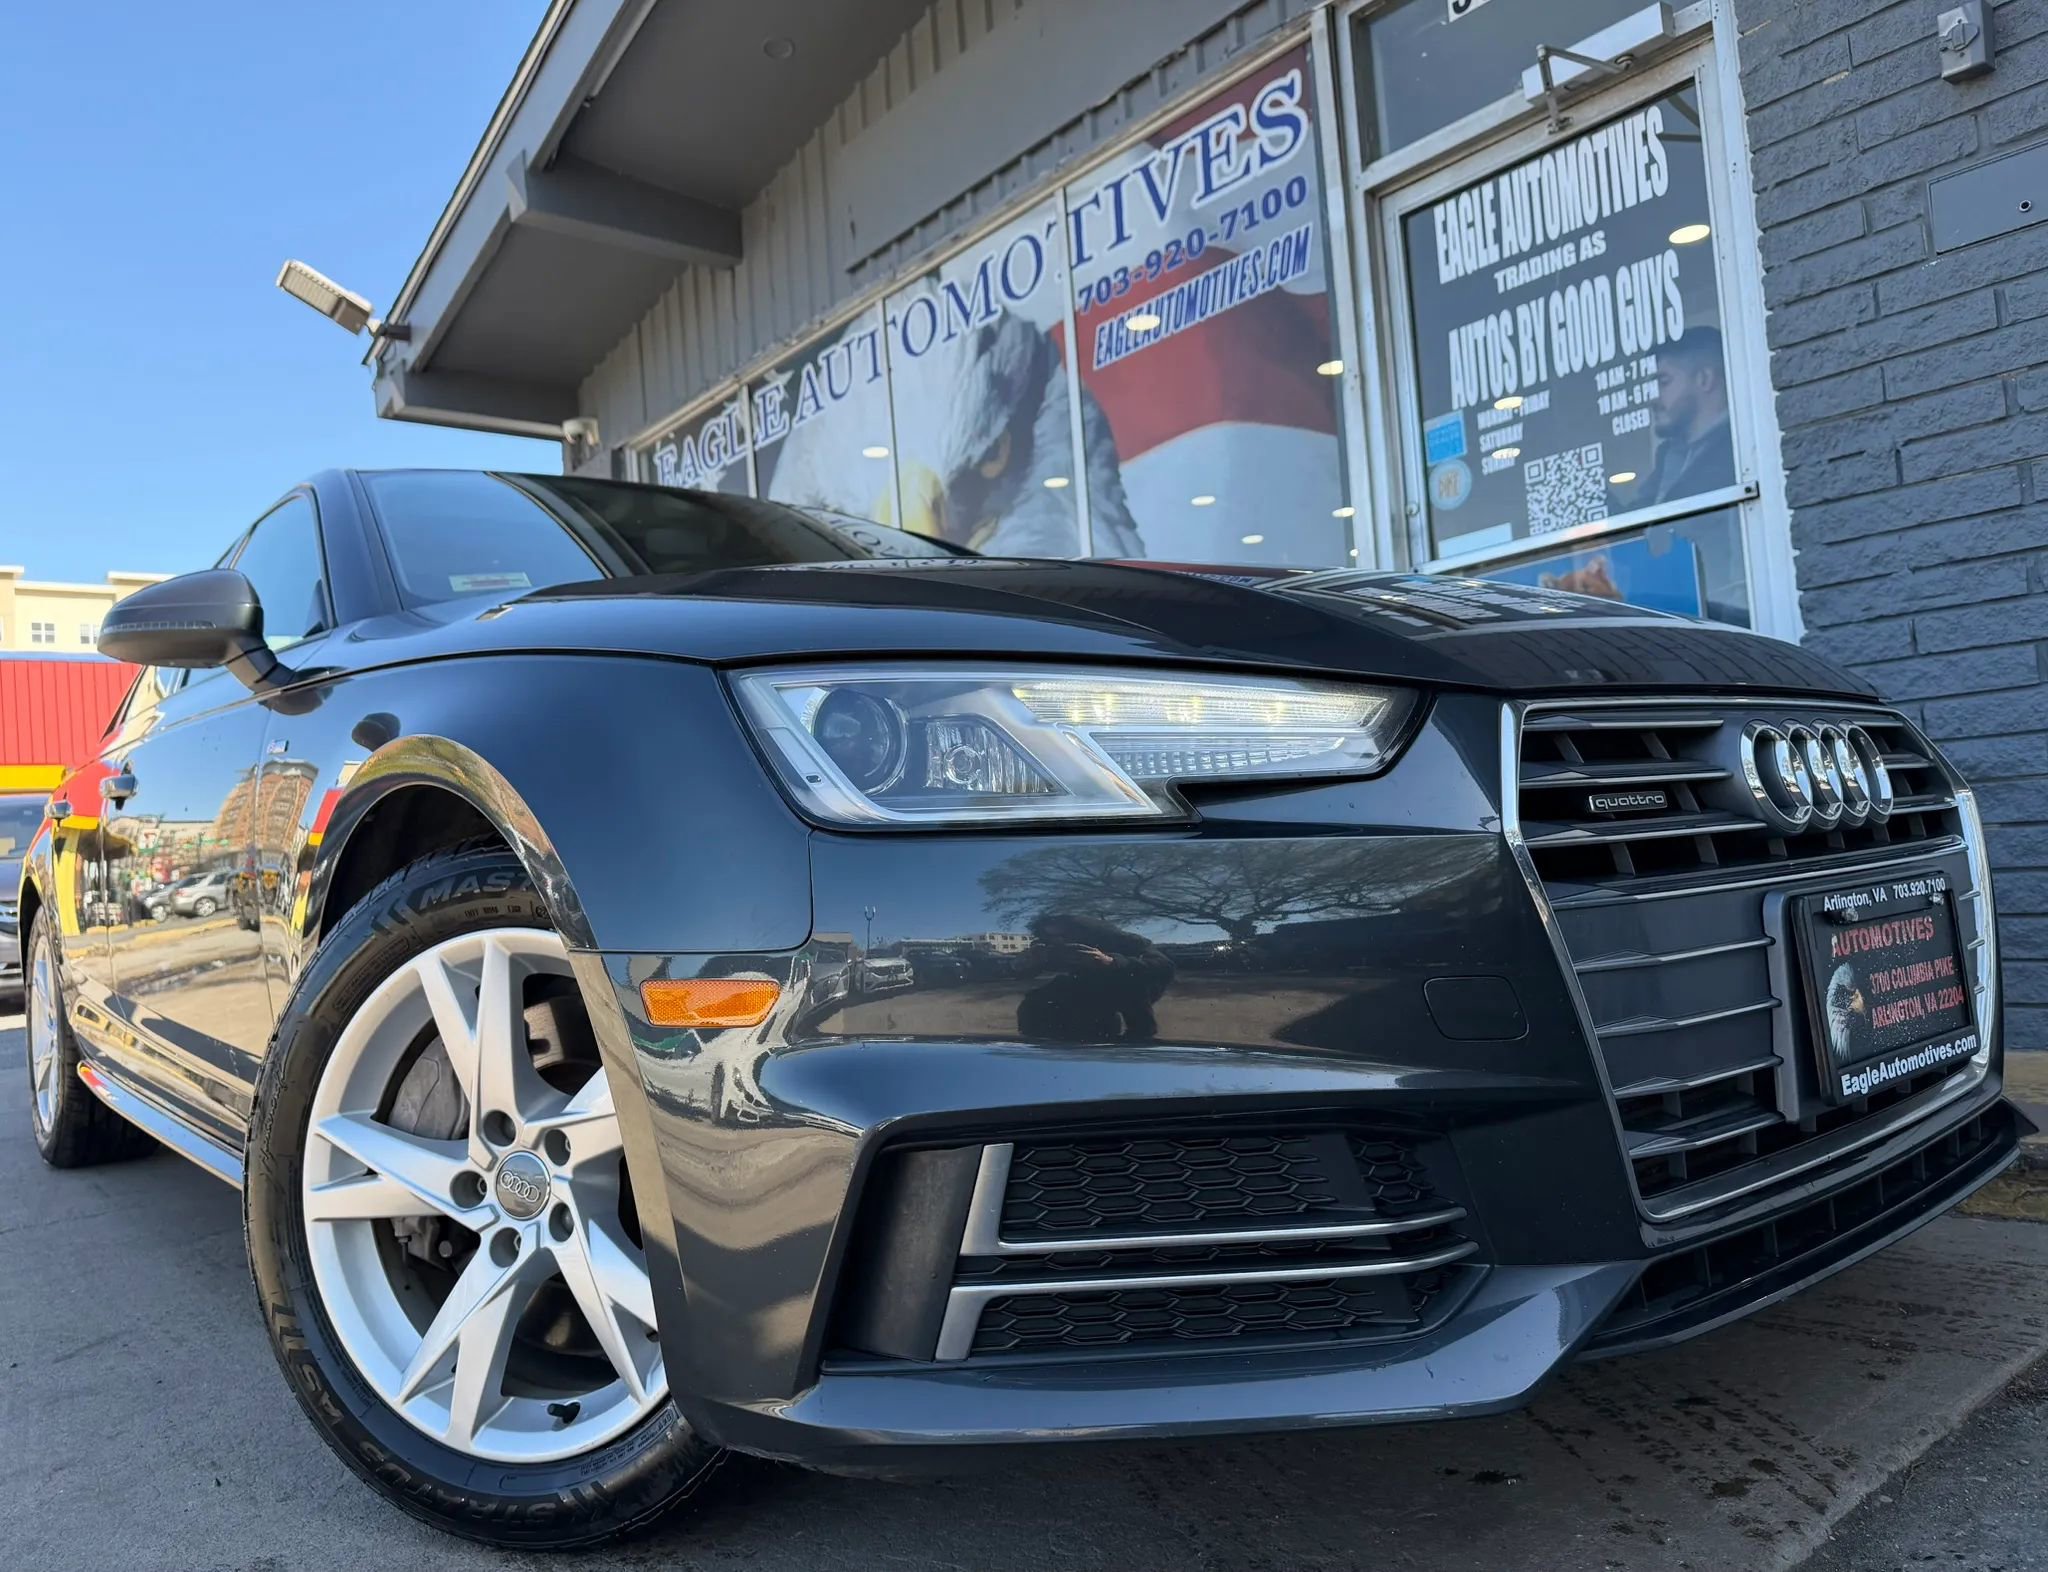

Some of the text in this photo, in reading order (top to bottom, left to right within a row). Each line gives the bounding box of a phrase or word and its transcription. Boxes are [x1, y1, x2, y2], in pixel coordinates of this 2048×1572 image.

[1433, 105, 1669, 285] EAGLE AUTOMOTIVES
[1079, 175, 1308, 315] 703-920-7100
[1494, 230, 1607, 294] TRADING AS
[654, 68, 1310, 488] EAGLE AUTOMOTIVES
[1093, 222, 1312, 371] EAGLEAUTOMOTIVES.COM
[1448, 247, 1685, 411] AUTOS BY GOOD GUYS
[1608, 364, 1626, 388] AM
[1630, 360, 1639, 381] 7
[1639, 354, 1659, 378] PM
[1610, 388, 1629, 412] AM
[1642, 379, 1660, 402] PM
[1612, 407, 1651, 437] CLOSED
[1595, 794, 1665, 810] quattro
[1823, 877, 1947, 913] Arlington, VA 703.920.7100
[1831, 914, 1936, 958] AUTOMOTIVES
[1869, 956, 1955, 995] 3700 COLUMBIA PIKE
[1871, 984, 1965, 1030] ARLINGTON, VA 22204
[1841, 1033, 1978, 1097] EagleAutomotives.com
